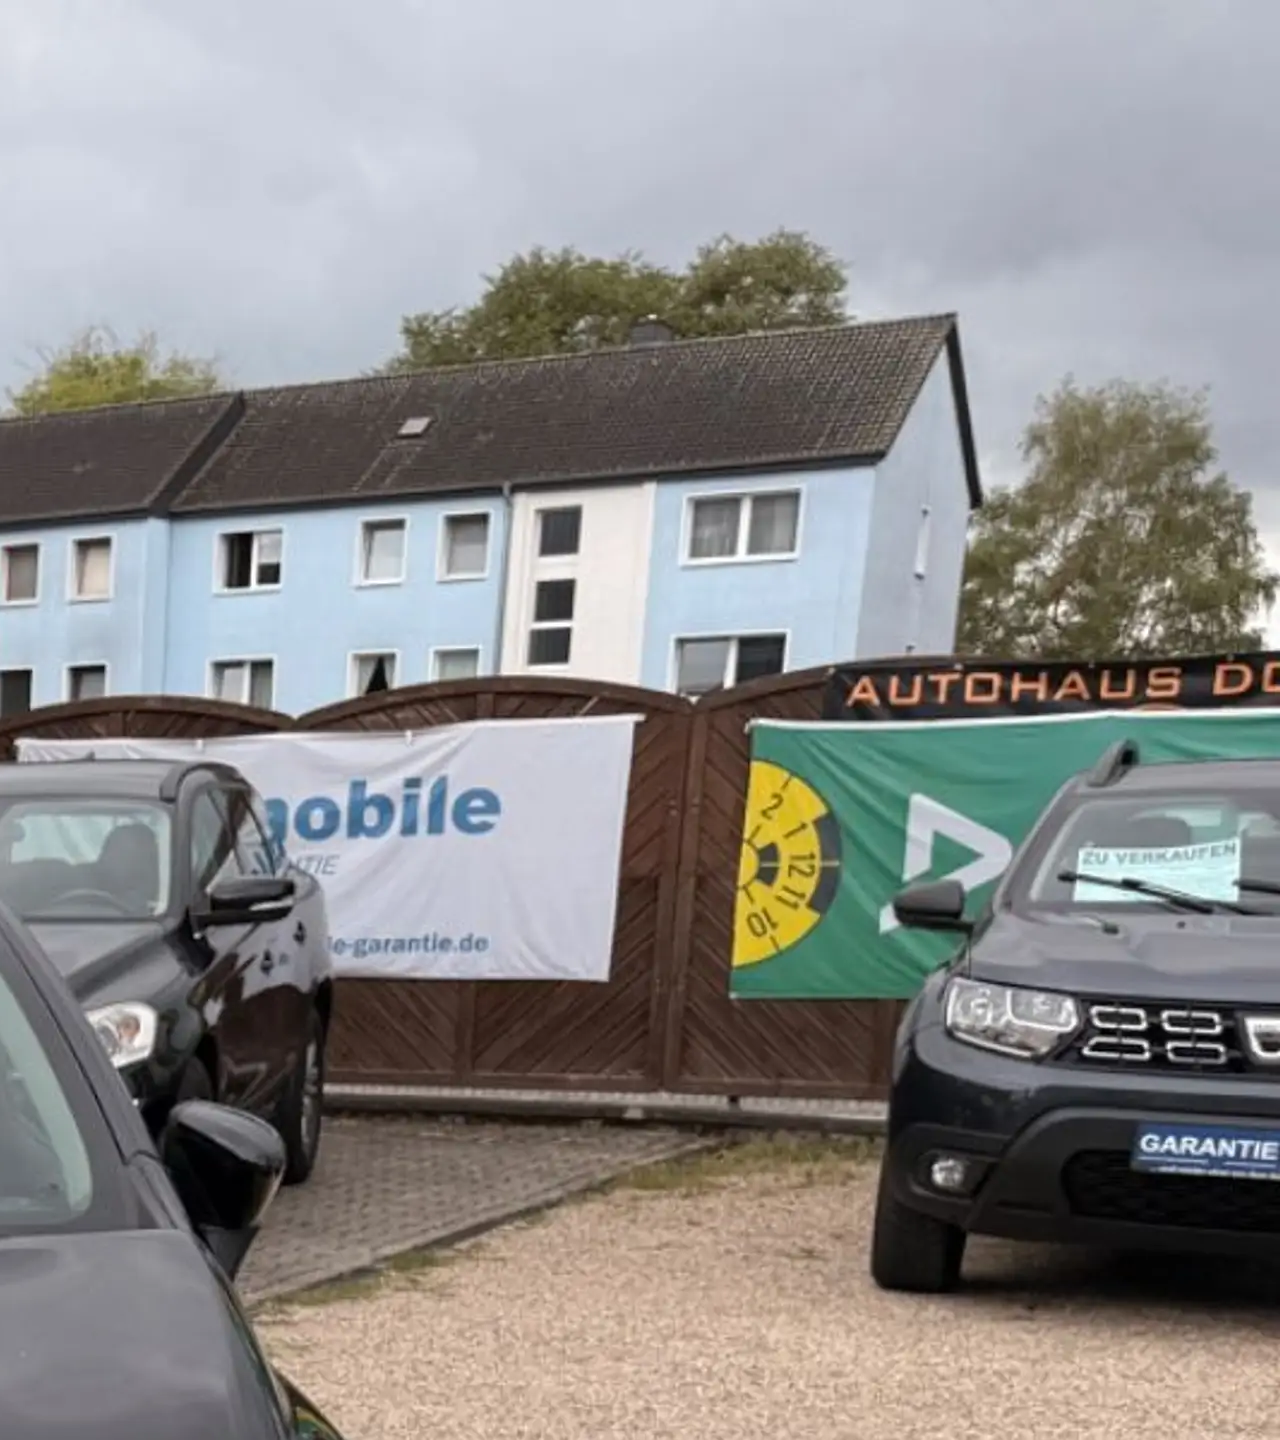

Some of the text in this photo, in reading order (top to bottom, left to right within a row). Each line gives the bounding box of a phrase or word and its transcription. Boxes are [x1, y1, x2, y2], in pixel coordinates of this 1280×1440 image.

[847, 668, 1183, 707] AUTOHAUS
[761, 793, 783, 820] 2
[788, 852, 816, 879] 12
[1083, 843, 1236, 866] ZU VERKAUFEN
[775, 885, 806, 911] 11
[746, 907, 779, 938] 10
[1140, 1132, 1279, 1161] GARANTIE
